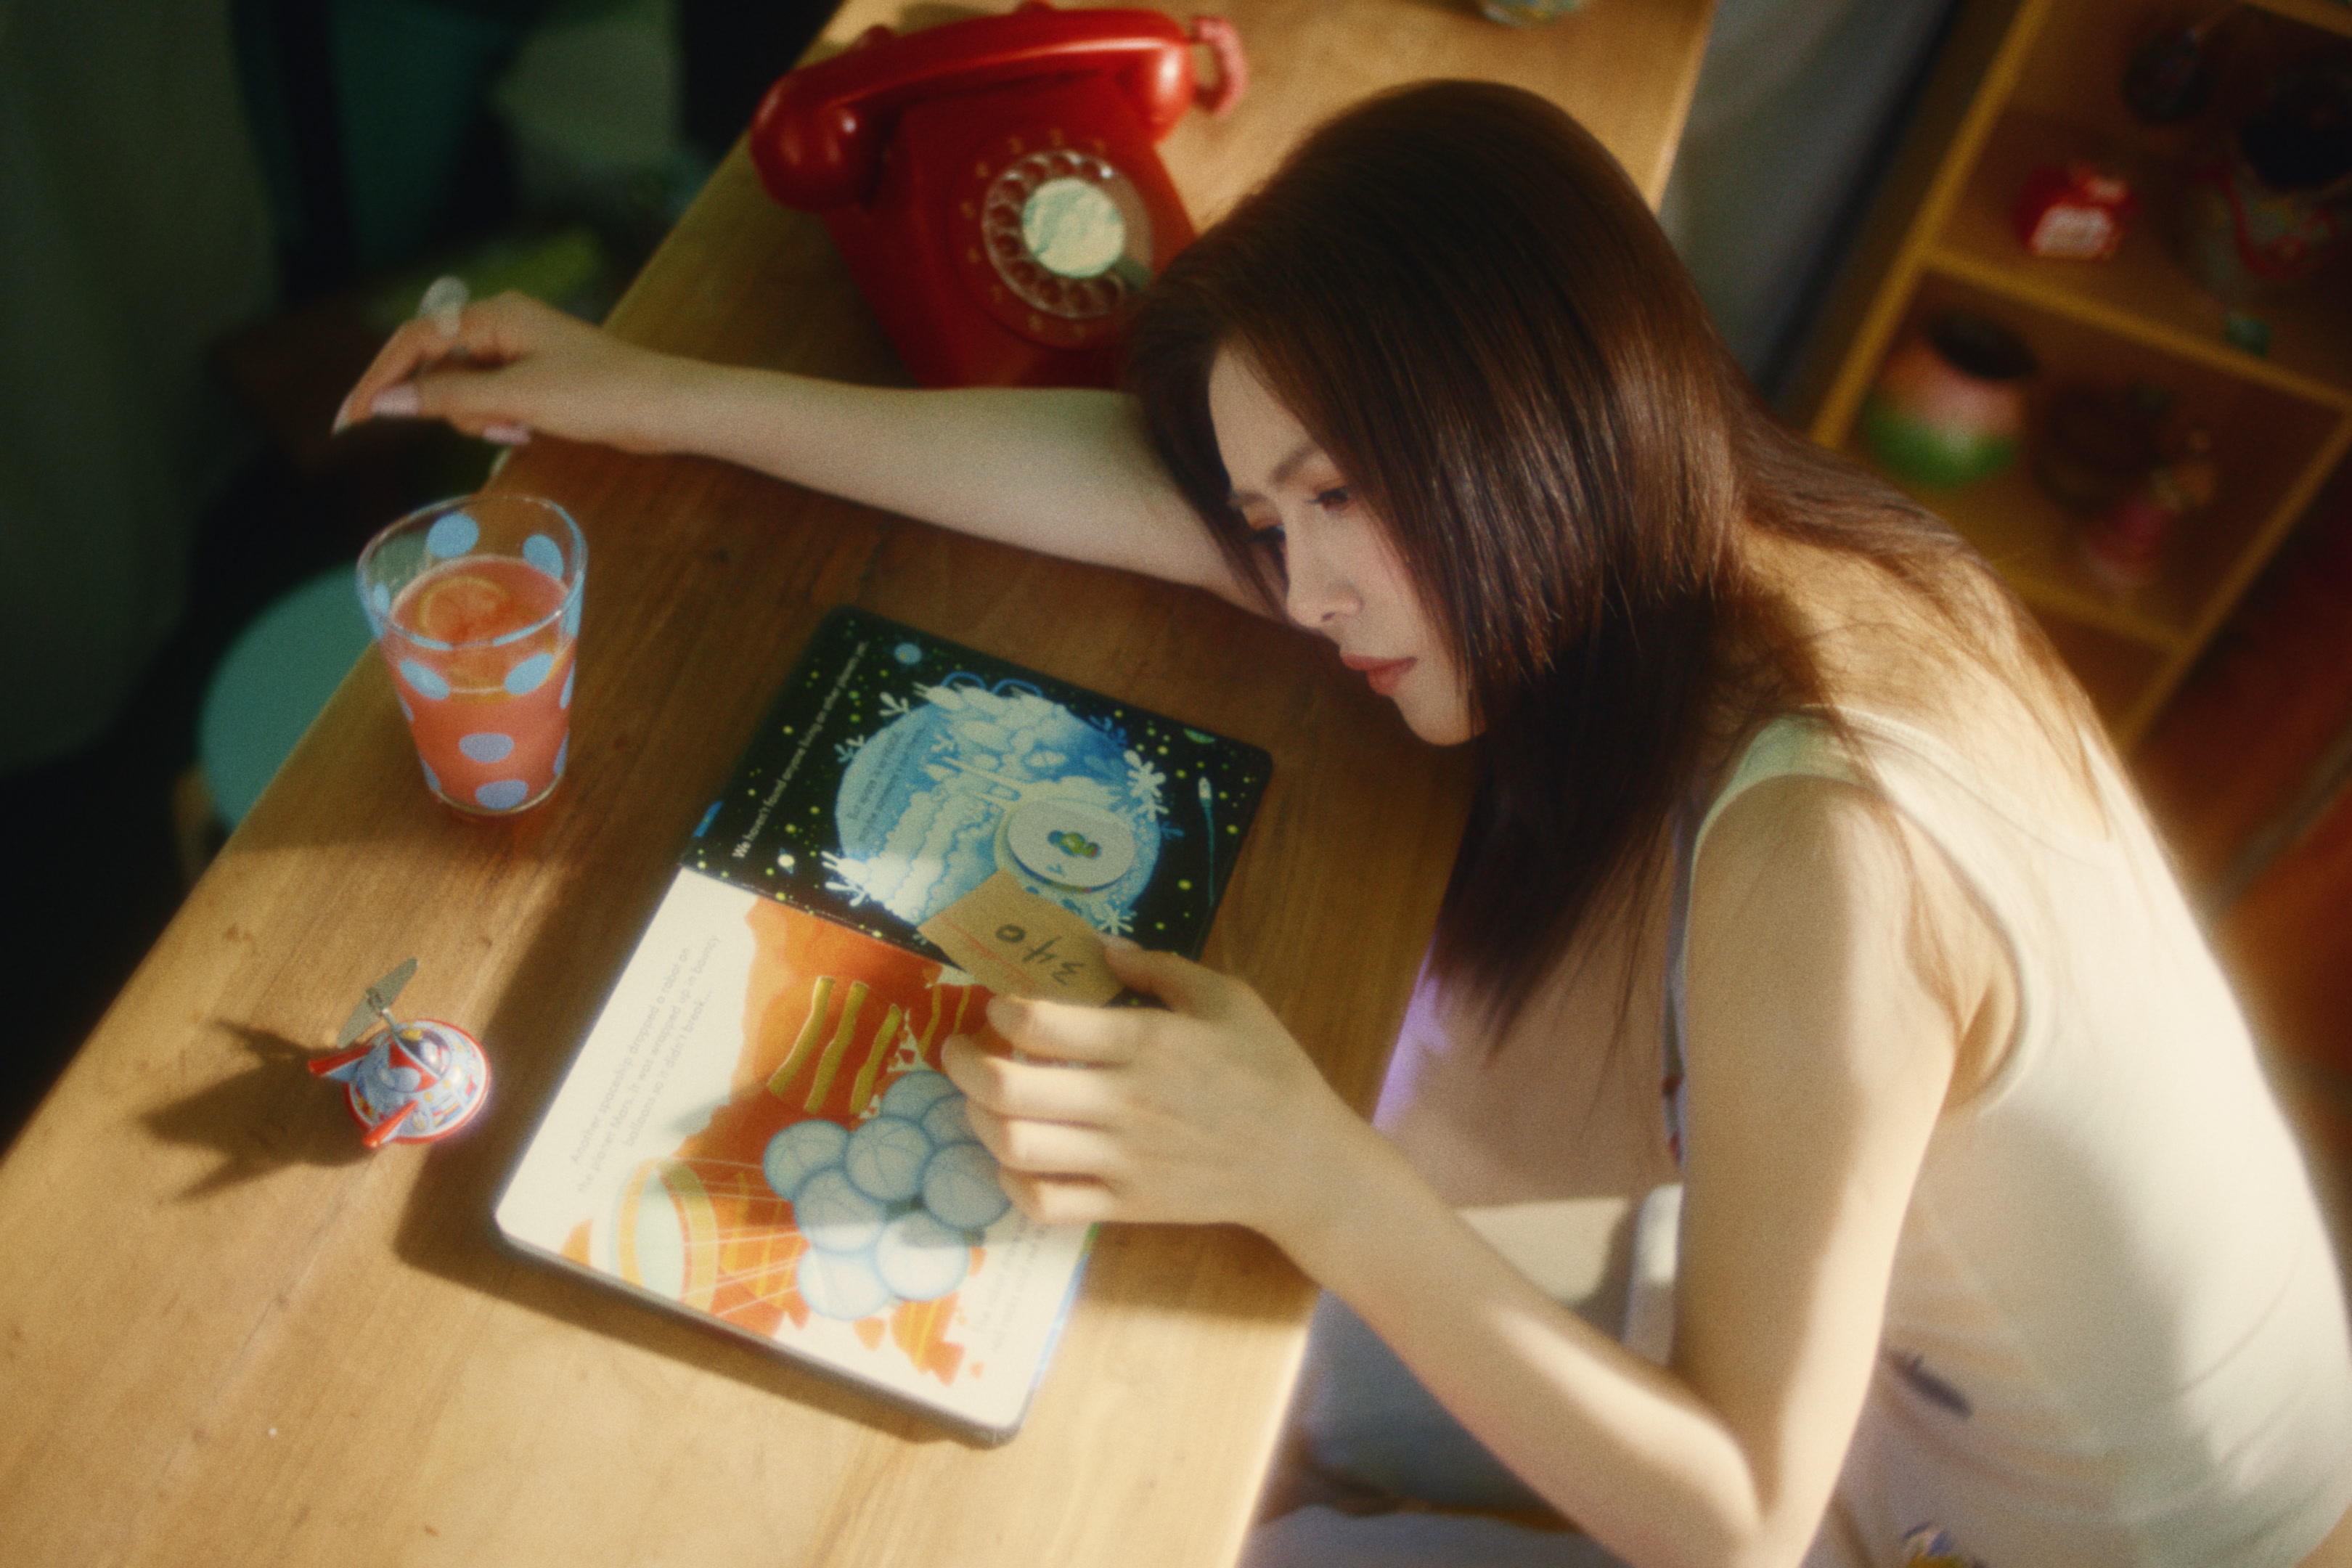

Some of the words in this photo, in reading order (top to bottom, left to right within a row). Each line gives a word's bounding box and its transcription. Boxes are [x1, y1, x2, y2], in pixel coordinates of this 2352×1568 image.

[732, 841, 751, 858] We
[743, 807, 769, 841] haven't
[762, 779, 787, 807] found
[782, 748, 804, 781] anyone
[690, 935, 721, 974] bouncy
[679, 989, 692, 1004] up
[687, 975, 698, 987] in
[651, 1005, 682, 1056] wrapped
[570, 1116, 600, 1165] Another
[598, 1057, 634, 1114] spaceship
[628, 1005, 660, 1055] dropped
[656, 995, 666, 1005] a
[661, 963, 681, 993] robot
[678, 947, 690, 963] on
[638, 1058, 654, 1081] was
[623, 1097, 656, 1147] balloons
[652, 1081, 665, 1095] so
[664, 1034, 687, 1069] didn't
[590, 1131, 615, 1172] planet
[576, 1173, 595, 1193] the
